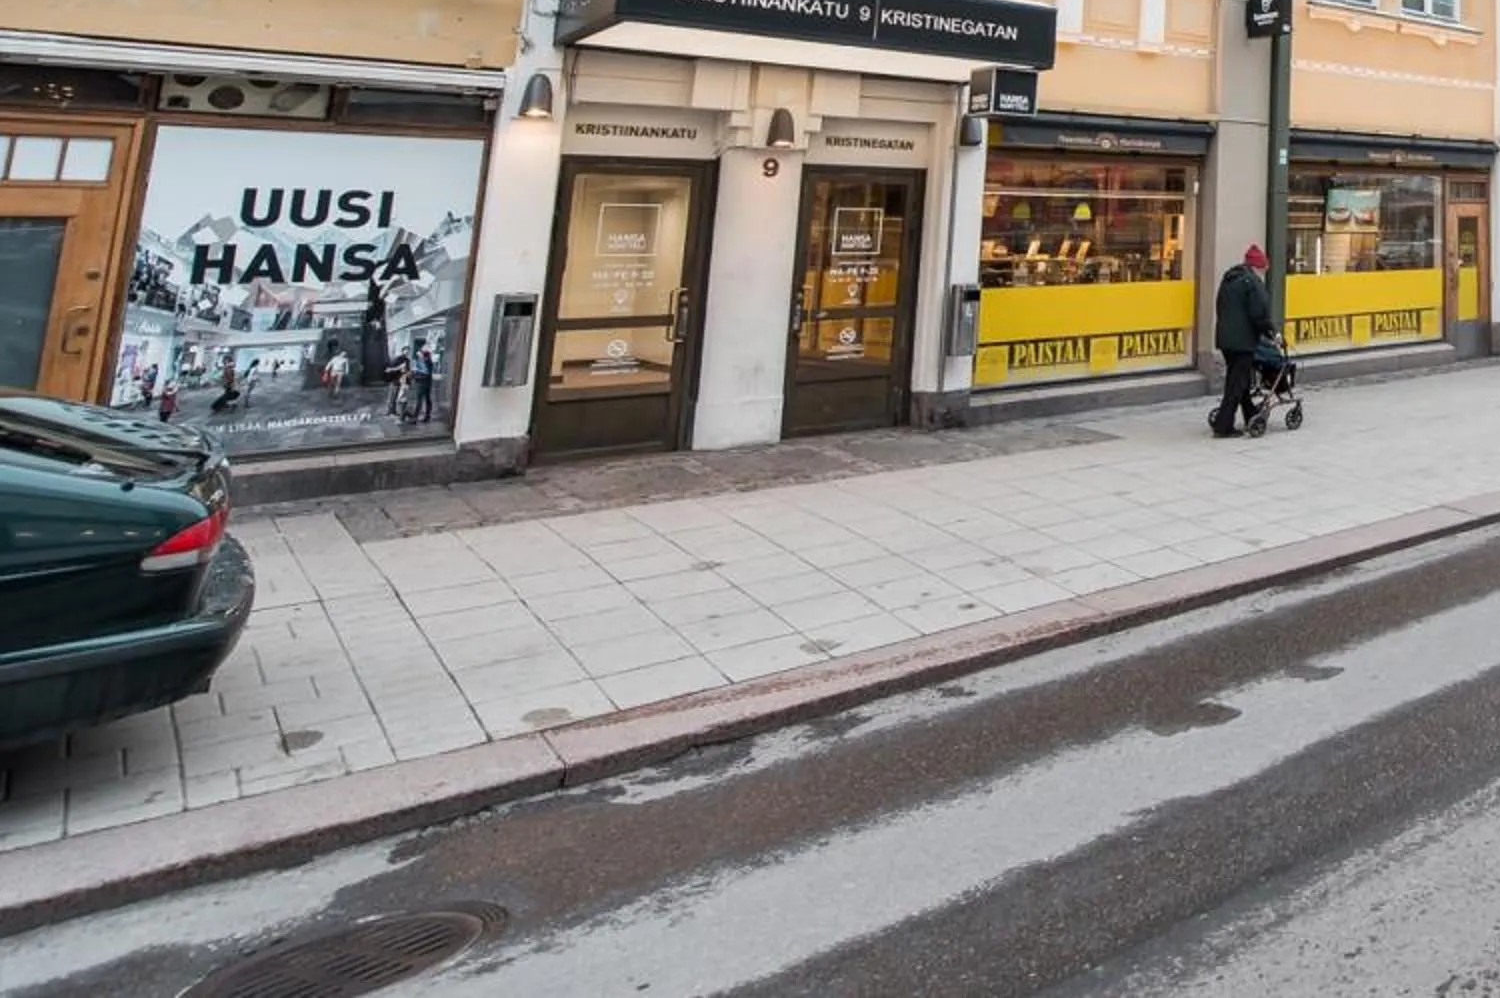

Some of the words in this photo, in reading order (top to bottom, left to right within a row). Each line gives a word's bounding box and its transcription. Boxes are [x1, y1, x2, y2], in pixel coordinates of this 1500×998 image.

[859, 5, 871, 21] 9
[881, 9, 1018, 41] KRISTINEGATAN
[575, 122, 697, 140] KRISTIINANKATU
[825, 136, 914, 152] KRISTINEGATAN
[763, 158, 779, 177] 9
[240, 187, 395, 228] UUSI
[190, 243, 420, 284] HANSA
[1014, 337, 1086, 368] PAISTAA
[1122, 329, 1185, 357] PAISTAA
